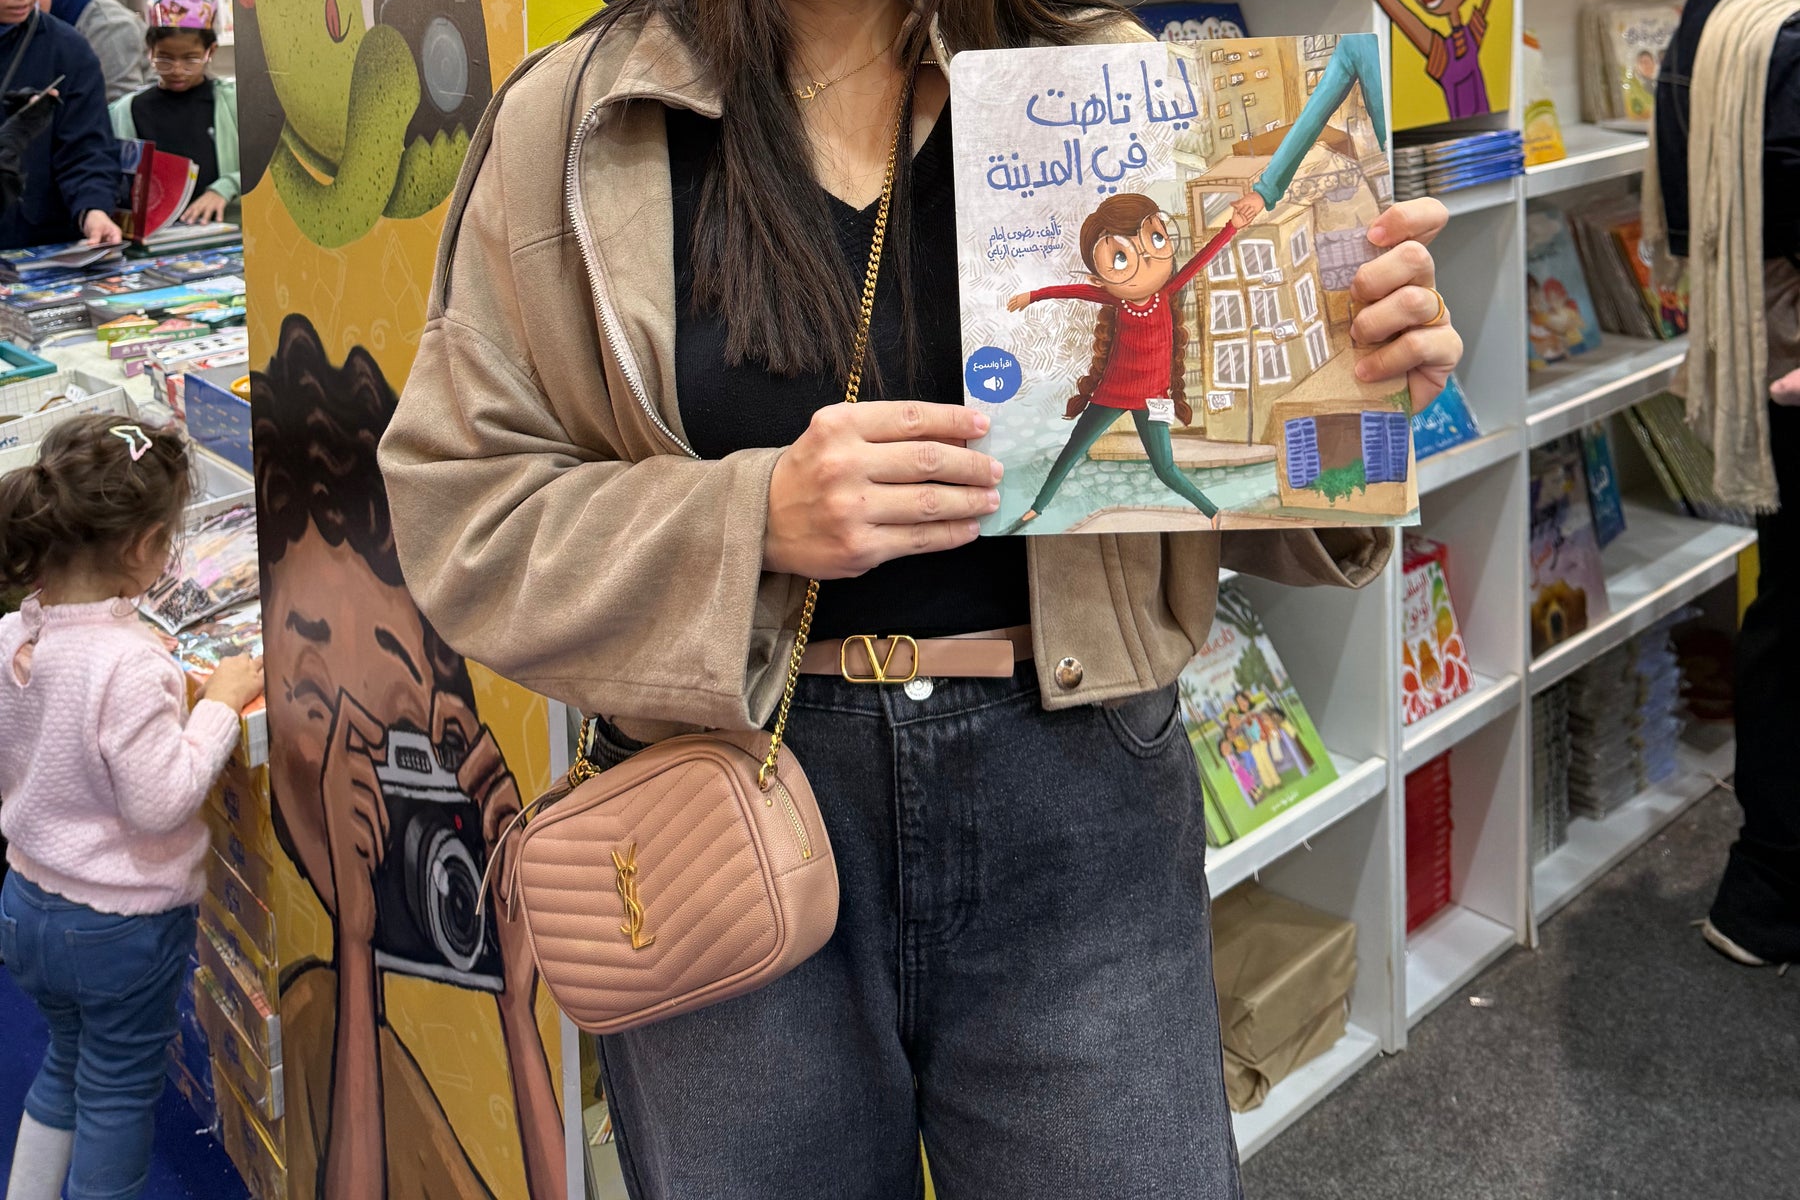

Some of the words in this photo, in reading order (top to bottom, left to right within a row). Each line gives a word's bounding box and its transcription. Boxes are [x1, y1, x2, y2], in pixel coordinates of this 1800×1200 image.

[1027, 63, 1132, 134] تاهت
[1141, 58, 1199, 131] لينا
[987, 138, 1083, 198] المدينة
[1091, 134, 1148, 193] في
[1011, 243, 1039, 258] حسين
[973, 360, 999, 372] واسمع
[1001, 357, 1012, 370] اقرأ
